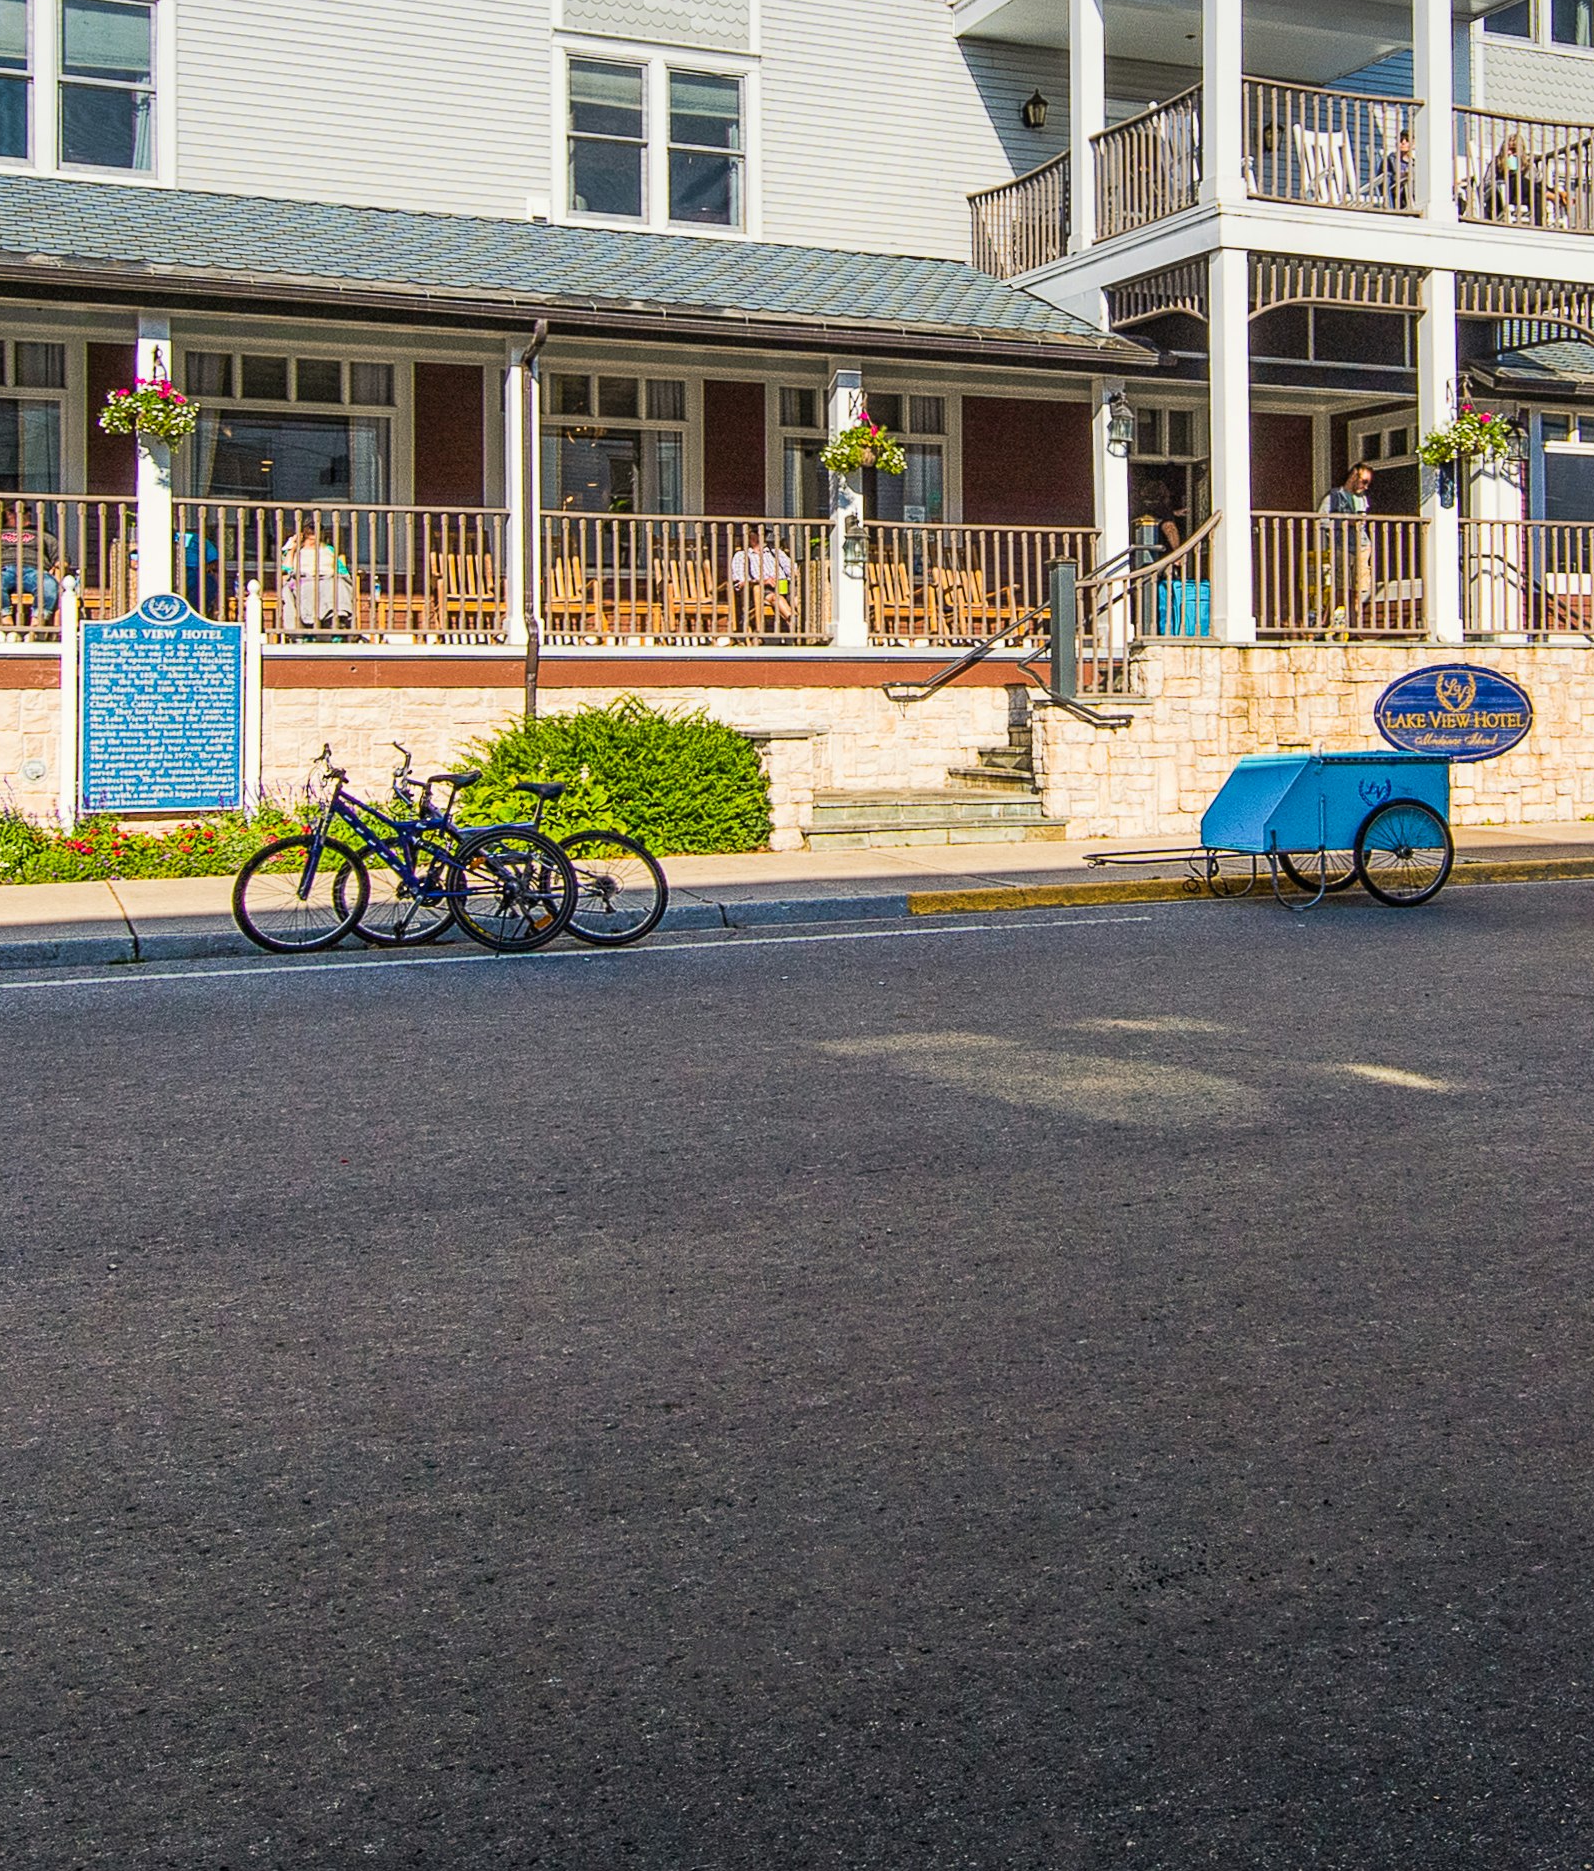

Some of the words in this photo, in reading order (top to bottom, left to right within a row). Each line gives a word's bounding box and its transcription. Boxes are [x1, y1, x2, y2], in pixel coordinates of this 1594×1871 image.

[102, 629, 138, 640] LAKE
[142, 629, 177, 640] VIEW
[182, 629, 224, 640] HOTEL
[1385, 711, 1426, 728] LAKE
[1428, 711, 1471, 728] VIEW
[1474, 713, 1525, 728] HOTEL
[1464, 732, 1498, 746] Island
